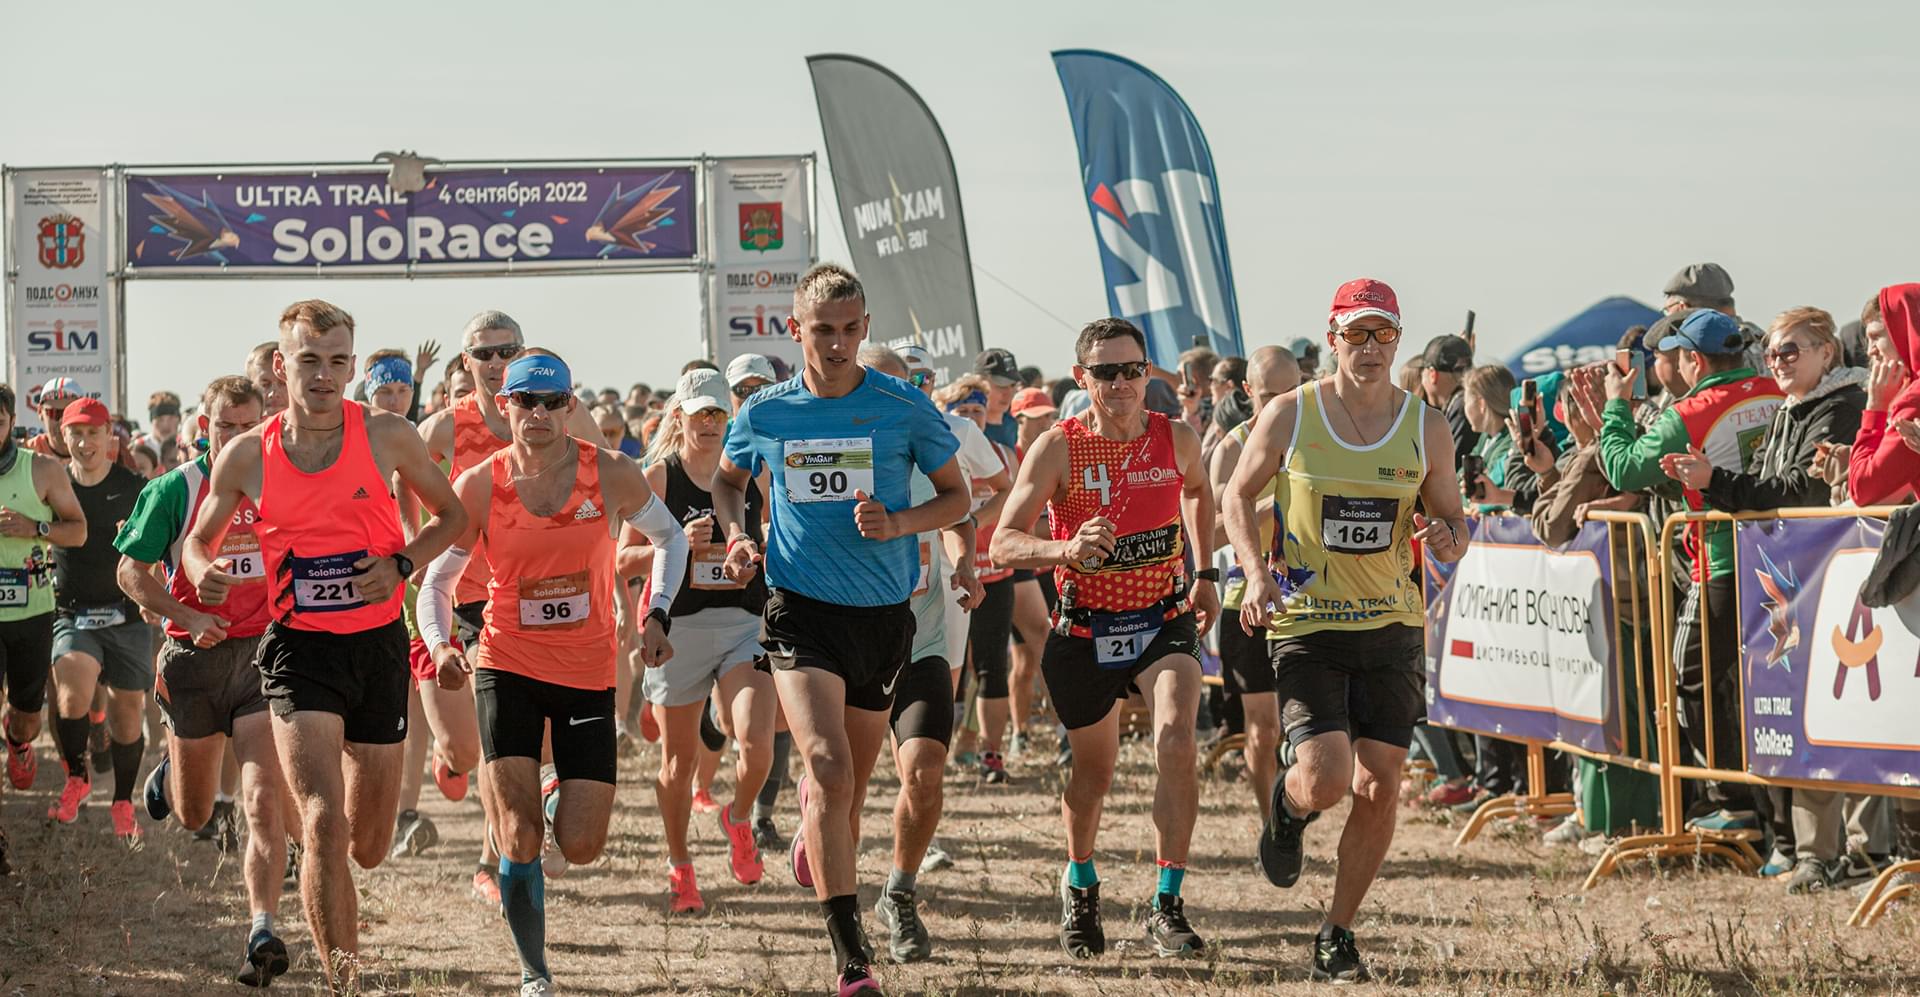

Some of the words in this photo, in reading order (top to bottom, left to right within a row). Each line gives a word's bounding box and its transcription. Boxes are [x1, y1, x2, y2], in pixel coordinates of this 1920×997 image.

[236, 185, 323, 207] ULTRA
[328, 184, 409, 206] TRAIL
[439, 184, 452, 205] 4
[455, 181, 541, 207] сентября
[545, 181, 588, 203] 2022
[272, 215, 554, 263] SoloRace
[26, 283, 99, 302] ПОДСОЛНУХ
[809, 471, 848, 495] 90
[1083, 463, 1112, 507] 4
[574, 510, 602, 520] adidas
[1339, 509, 1382, 519] SoloRace
[1338, 525, 1379, 544] 164
[222, 542, 259, 553] SoloRace
[308, 566, 353, 578] SoloRace
[311, 582, 355, 602] 221
[533, 585, 577, 597] SoloRace
[541, 602, 571, 621] 96
[1304, 596, 1354, 611] ULTRA
[1358, 595, 1399, 609] TRAIL
[1108, 622, 1149, 633] SoloRace
[1111, 638, 1135, 658] 21
[1754, 726, 1794, 757] SoloRace
